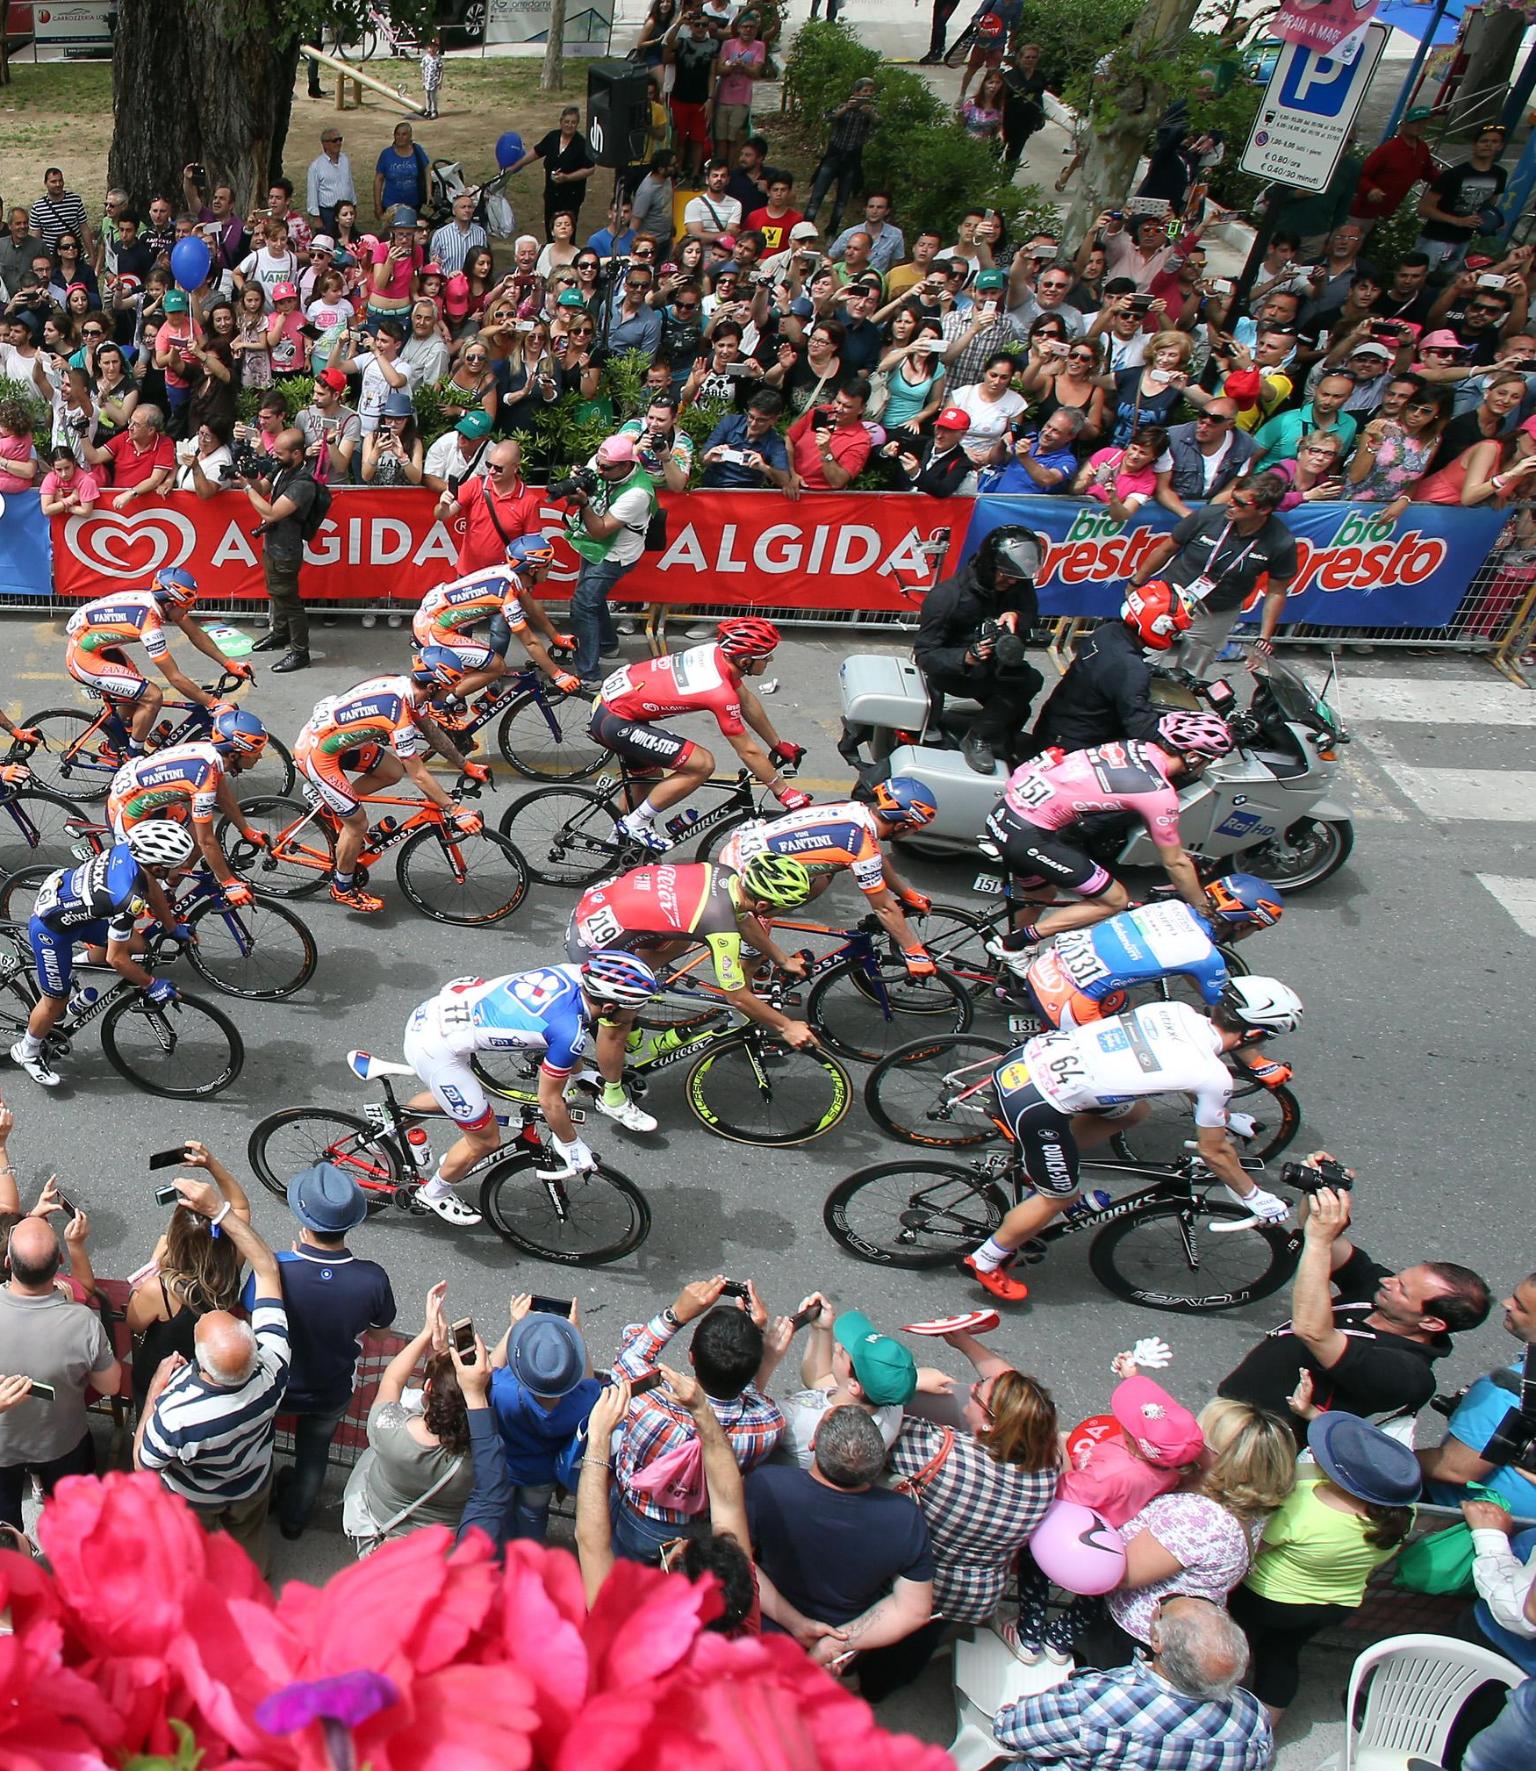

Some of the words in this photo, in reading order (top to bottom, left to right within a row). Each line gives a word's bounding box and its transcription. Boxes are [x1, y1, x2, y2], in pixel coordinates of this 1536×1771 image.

[1279, 12, 1307, 35] PRAIA
[1294, 50, 1344, 100] P
[260, 270, 289, 283] VANS
[1070, 508, 1125, 541] bio
[1332, 510, 1398, 548] bio
[211, 518, 459, 567] AGIDA
[656, 522, 932, 579] ALGIDA
[450, 587, 489, 603] FANTINI
[93, 611, 127, 624] FANTINI
[104, 682, 136, 697] NIPPO
[340, 704, 379, 723] FANTINI
[476, 713, 490, 726] DE
[489, 690, 518, 716] ROSA
[143, 768, 185, 787] FANTINI
[600, 776, 613, 788] 61
[1013, 774, 1052, 806] 151
[674, 809, 731, 844] -WORKS
[1224, 817, 1254, 833] Rai
[1253, 823, 1276, 837] HD
[373, 838, 386, 854] DE
[387, 829, 415, 846] ROSA
[778, 835, 833, 852] FANTINI
[1035, 851, 1074, 875] GIANT
[976, 878, 999, 893] 151
[586, 909, 617, 944] 219
[72, 987, 121, 1029] S-WORKS
[1013, 1018, 1038, 1031] 131
[1050, 1053, 1071, 1086] 64
[989, 1154, 1007, 1168] 64
[1041, 1144, 1073, 1191] QUICK-STEP
[1062, 1193, 1157, 1233] S-WORKS
